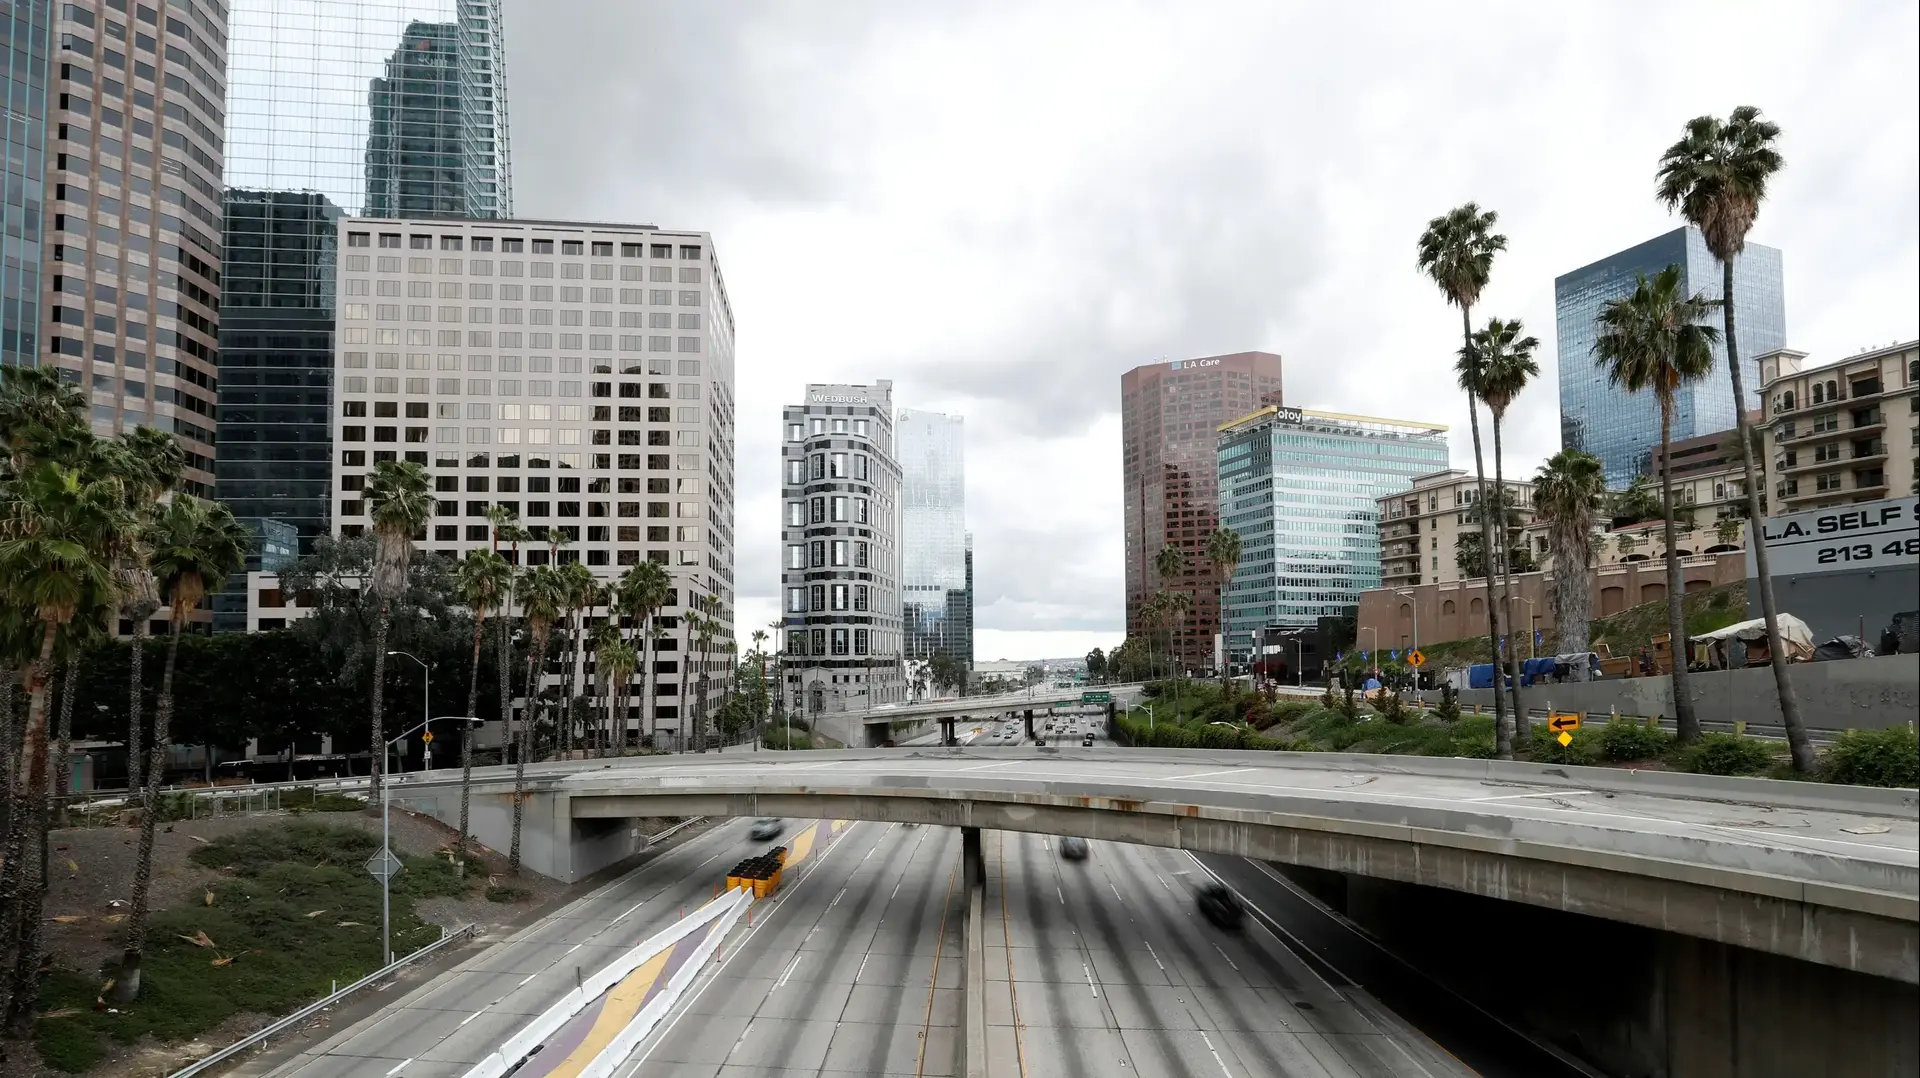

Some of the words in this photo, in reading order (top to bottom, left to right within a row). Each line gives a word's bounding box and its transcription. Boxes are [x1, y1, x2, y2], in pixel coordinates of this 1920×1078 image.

[1200, 359, 1220, 367] Care
[811, 394, 868, 404] WEDBUSH
[1278, 408, 1302, 423] otoy
[1762, 521, 1811, 541] L.A.
[1817, 505, 1902, 534] SELF
[1818, 544, 1873, 564] 213
[1882, 539, 1919, 556] 48
